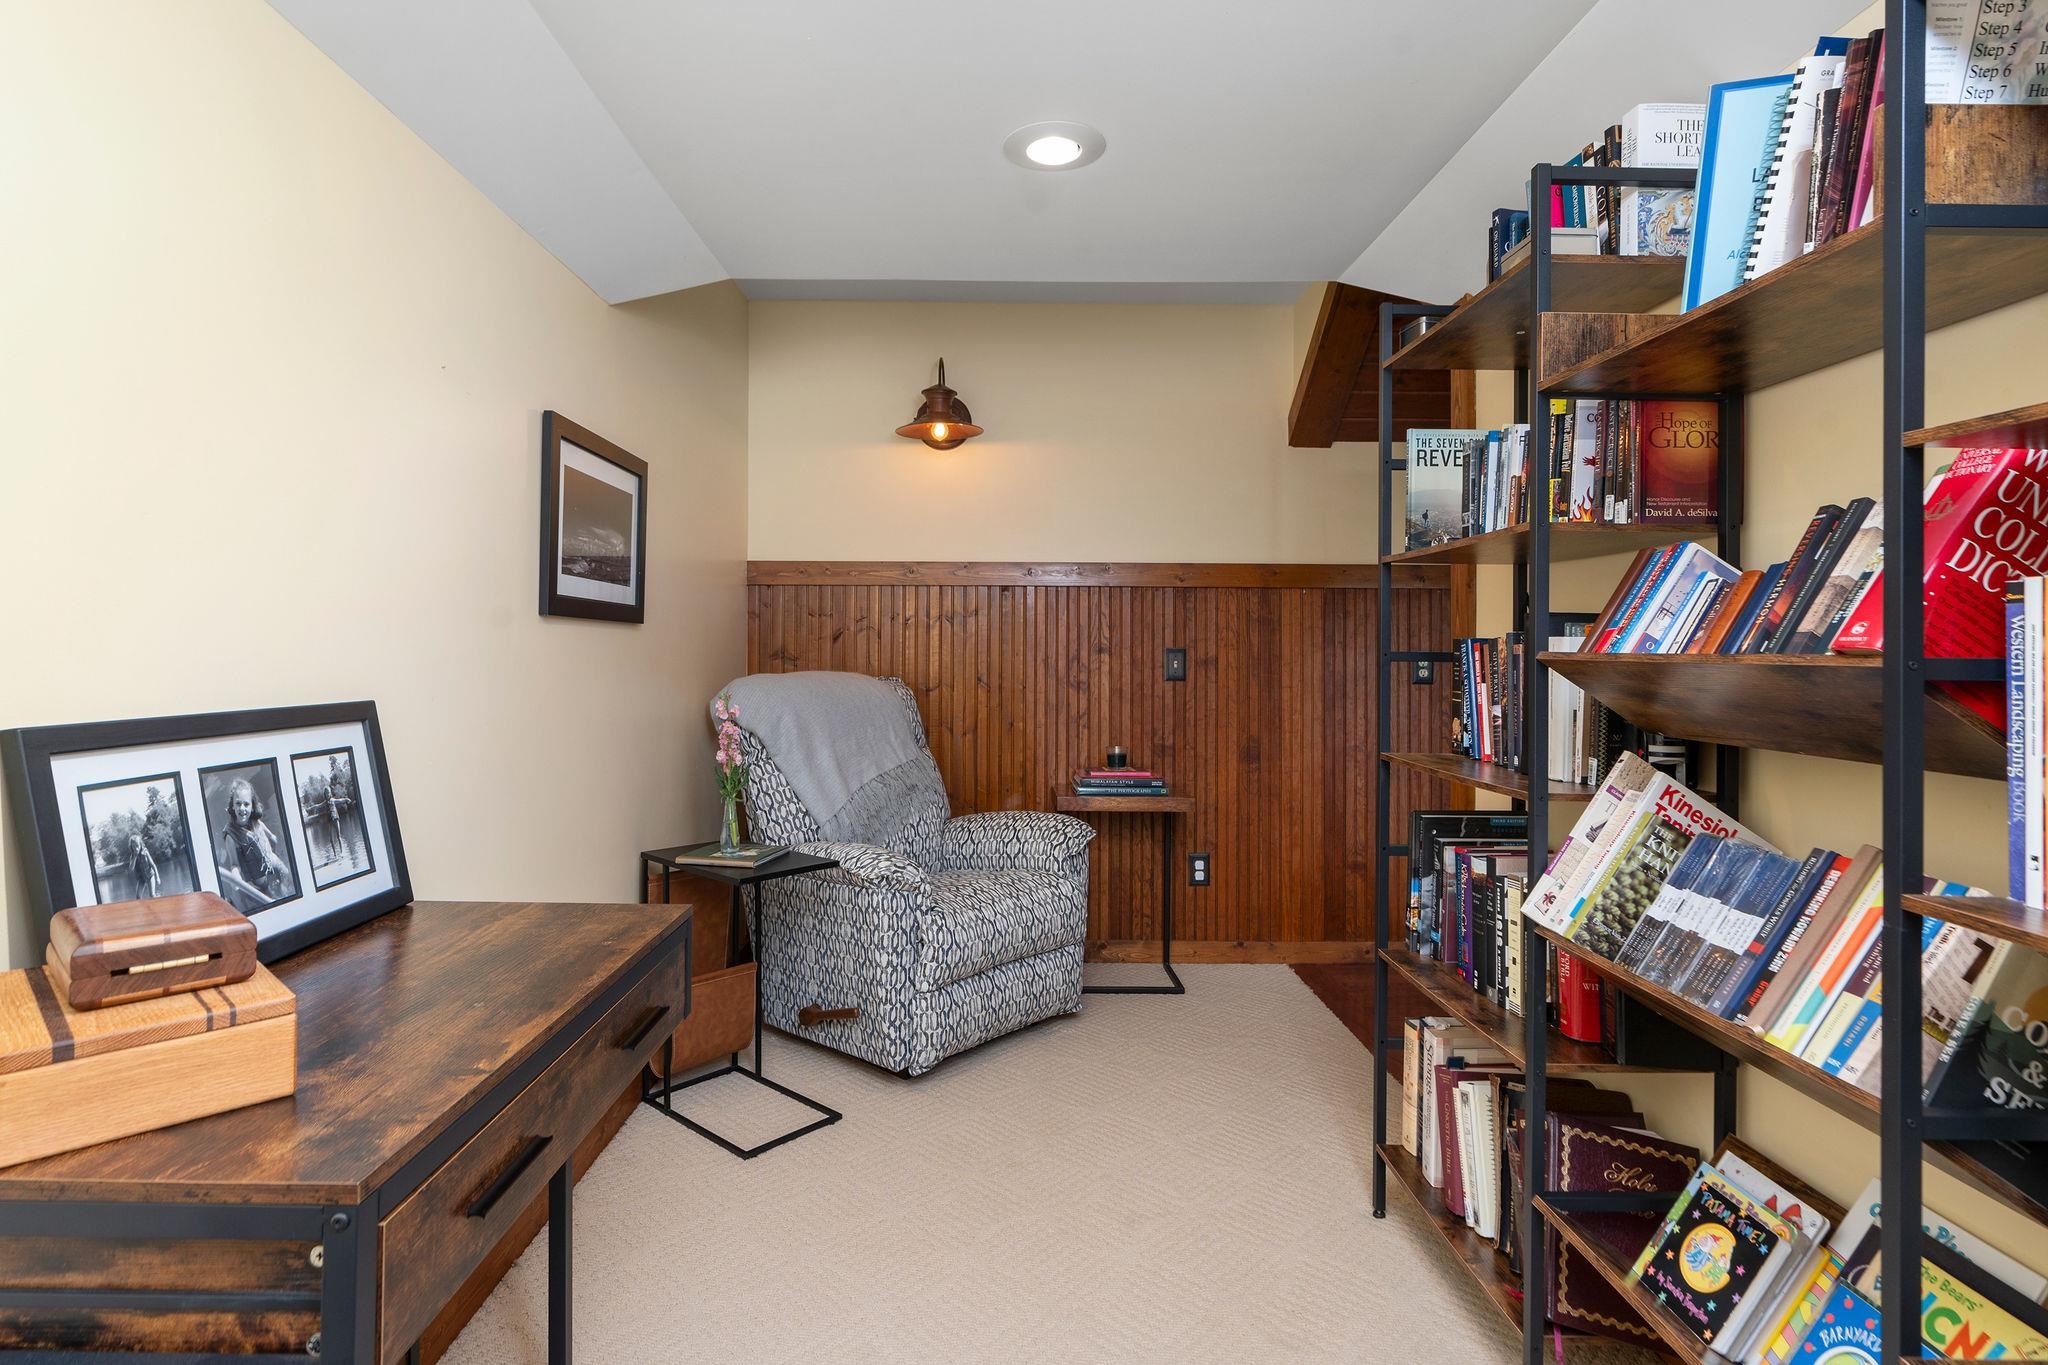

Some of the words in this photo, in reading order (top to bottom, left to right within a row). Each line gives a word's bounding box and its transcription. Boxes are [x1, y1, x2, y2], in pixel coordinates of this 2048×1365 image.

[1983, 0, 2014, 16] Step
[2018, 0, 2026, 12] 3
[1979, 22, 2010, 38] Step
[2013, 20, 2022, 34] 4
[1974, 43, 2004, 60] Step
[2008, 42, 2018, 56] 5
[1968, 64, 1999, 82] Step
[2003, 63, 2013, 78] 6
[1964, 85, 1994, 102] Step
[2000, 84, 2008, 98] 7
[1654, 132, 1702, 144] SHORT
[1677, 120, 1704, 131] THE
[1676, 145, 1701, 157] LEA
[1660, 412, 1697, 432] Hope
[1416, 438, 1432, 448] THE
[1436, 438, 1464, 448] SEVEN
[1648, 426, 1719, 448] GLOR
[1416, 450, 1462, 467] REVE
[1998, 468, 2048, 528] UN
[1645, 508, 1672, 517] David
[1675, 508, 1685, 517] A.
[1687, 508, 1718, 517] deSilva
[1974, 506, 2048, 578] COLL
[1945, 538, 2028, 592] DIC
[1754, 578, 1786, 625] HERMON
[2010, 614, 2024, 675] Western
[2006, 680, 2024, 778] Landscaping
[1659, 784, 1738, 840] Kinesiol
[2011, 780, 2024, 822] Book
[1654, 825, 1674, 843] THE
[1646, 834, 1681, 861] KNI
[1638, 848, 1670, 876] HAN
[1803, 866, 1842, 918] DEBUNKING
[1780, 913, 1812, 954] HOWARD
[1767, 949, 1788, 974] ZINN
[1582, 982, 1600, 990] WIT
[1862, 969, 1874, 984] and
[2002, 1006, 2048, 1048] CO
[1984, 1076, 2045, 1110] SE
[1604, 1162, 1659, 1192] Holy
[1940, 1279, 1984, 1312] Bears'
[1920, 1291, 2007, 1360] ICNI
